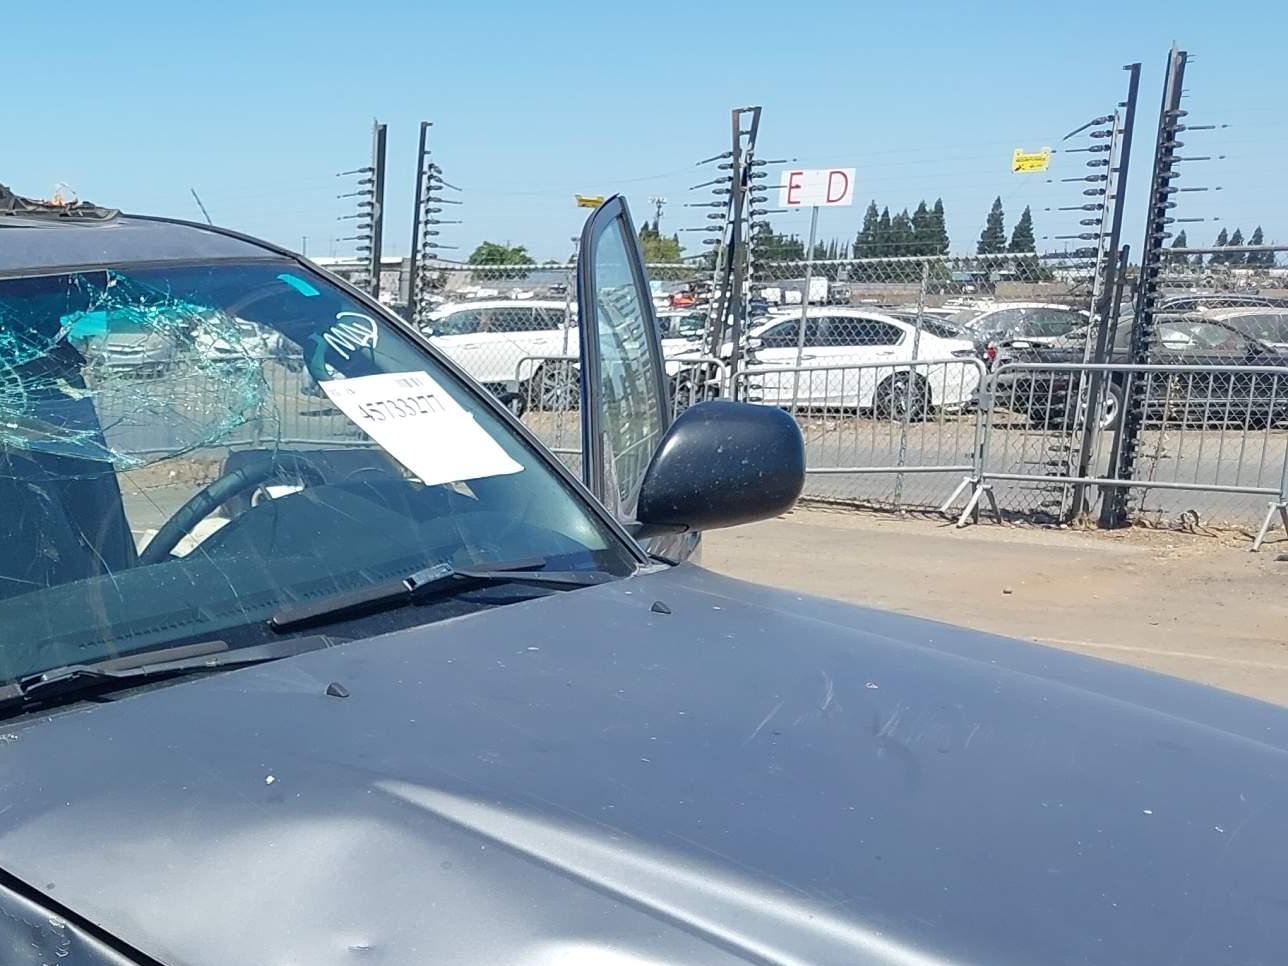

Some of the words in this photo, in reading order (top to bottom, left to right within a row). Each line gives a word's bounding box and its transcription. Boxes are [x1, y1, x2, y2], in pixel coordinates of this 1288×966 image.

[787, 171, 804, 205] E
[826, 170, 849, 203] D
[358, 393, 446, 422] 45733277
